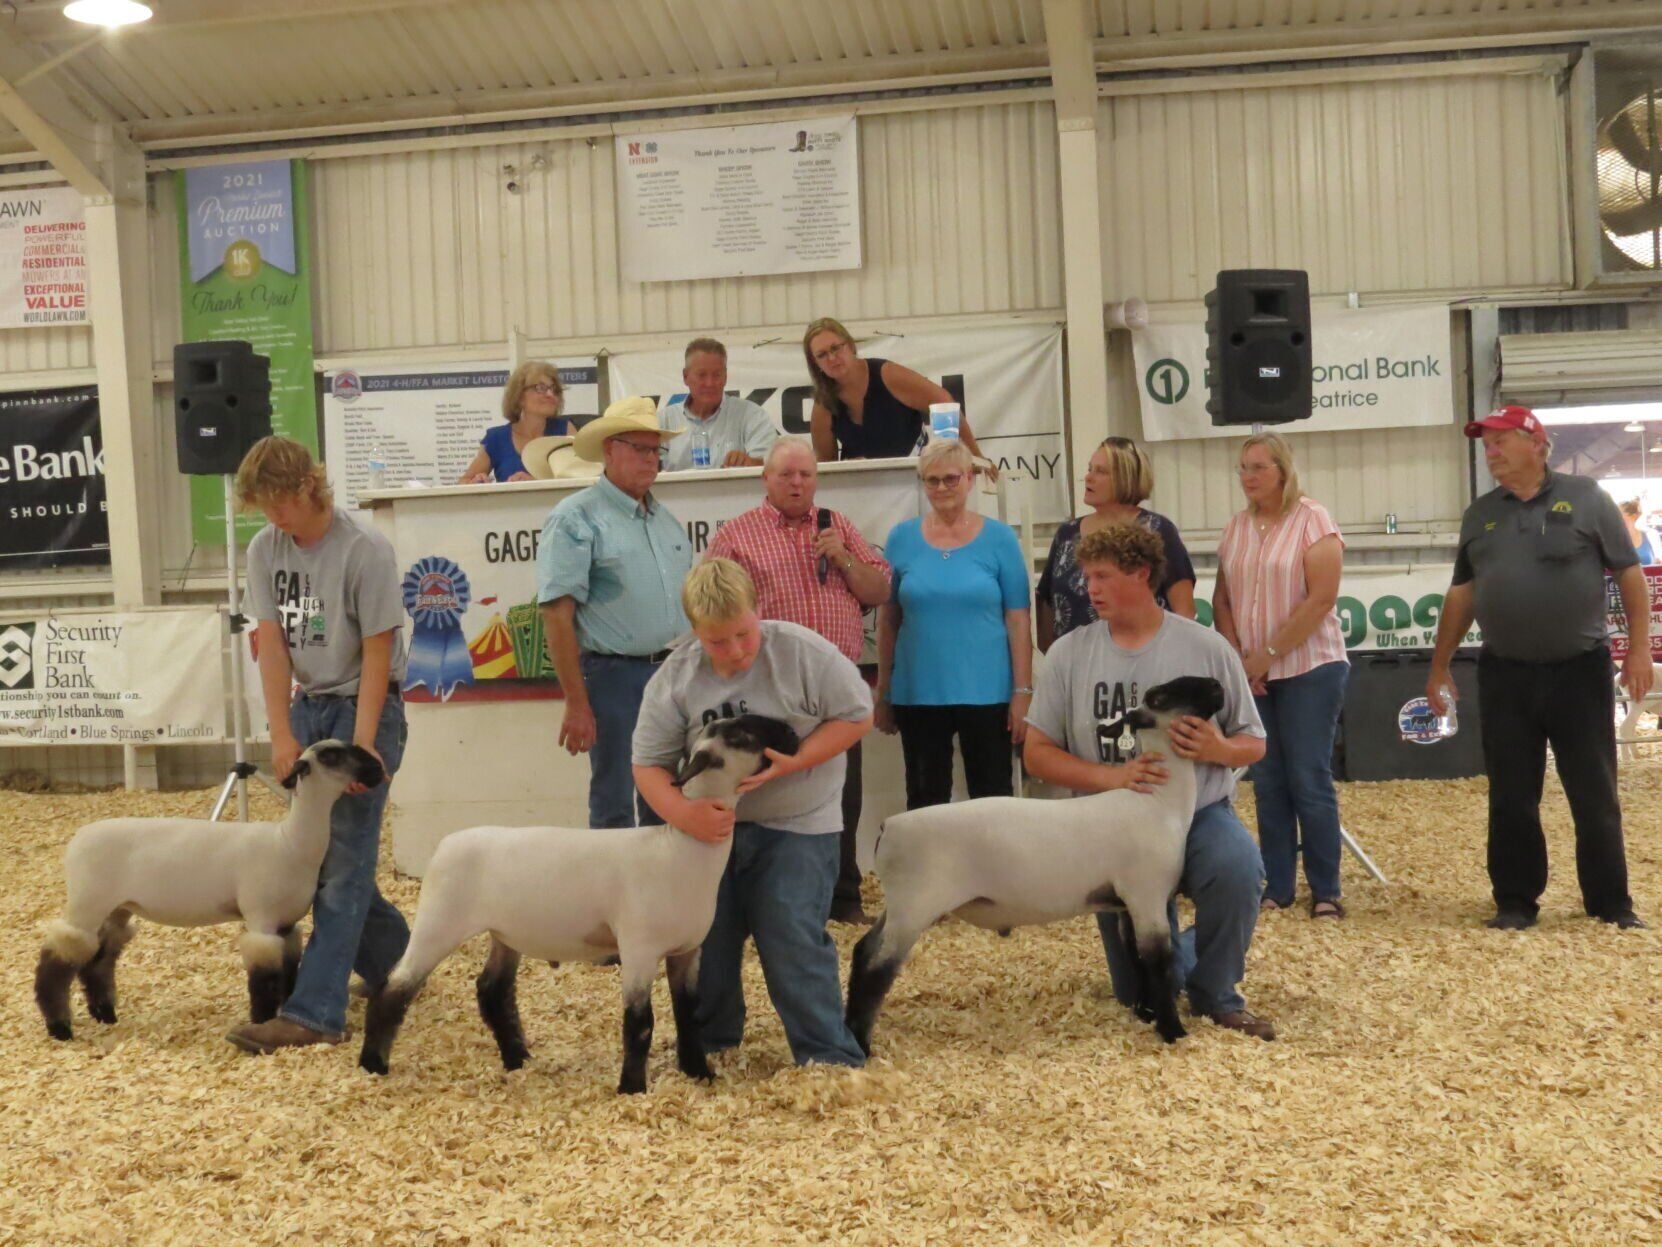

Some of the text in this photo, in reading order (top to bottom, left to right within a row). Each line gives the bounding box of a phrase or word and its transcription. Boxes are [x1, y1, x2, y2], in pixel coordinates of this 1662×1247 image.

[223, 172, 263, 189] 2021
[198, 196, 285, 227] Premium
[24, 222, 86, 235] DELIVERING
[203, 222, 280, 240] AUCTION
[22, 256, 86, 269] RESIDENTIAL
[24, 283, 86, 296] EXCEPTIONAL
[25, 295, 86, 310] VALUE
[192, 290, 246, 315] Thank
[1376, 354, 1441, 379] Bank
[367, 379, 390, 389] 2021
[431, 376, 470, 386] MARKET
[10, 502, 87, 519] SHOULD
[274, 569, 300, 608] GA
[45, 616, 123, 648] Security
[1376, 632, 1418, 648] When
[45, 641, 87, 665] First
[45, 665, 96, 689] Bank
[46, 691, 67, 703] you
[70, 691, 90, 700] can
[1093, 681, 1127, 720] GA
[80, 724, 107, 739] Blue
[110, 725, 155, 741] Springs
[167, 723, 214, 739] Lincoln
